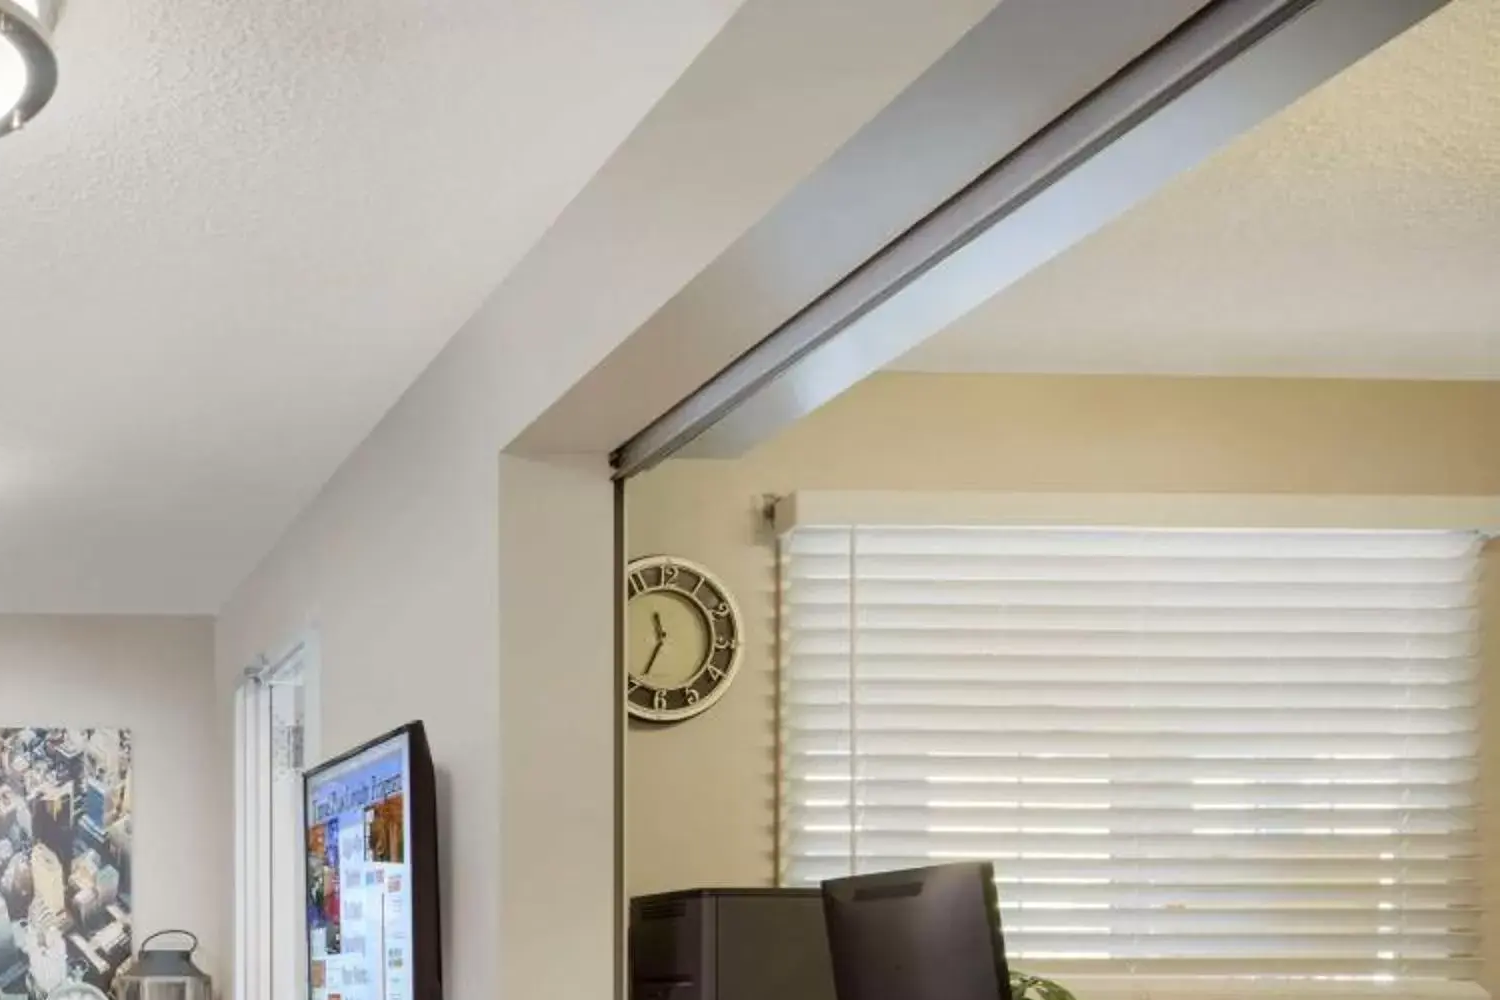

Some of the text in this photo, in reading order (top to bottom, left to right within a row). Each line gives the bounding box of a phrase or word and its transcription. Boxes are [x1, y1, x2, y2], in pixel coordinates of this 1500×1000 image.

[661, 565, 679, 590] 12
[709, 601, 730, 622] 2
[654, 688, 668, 711] 6
[684, 686, 700, 706] 5
